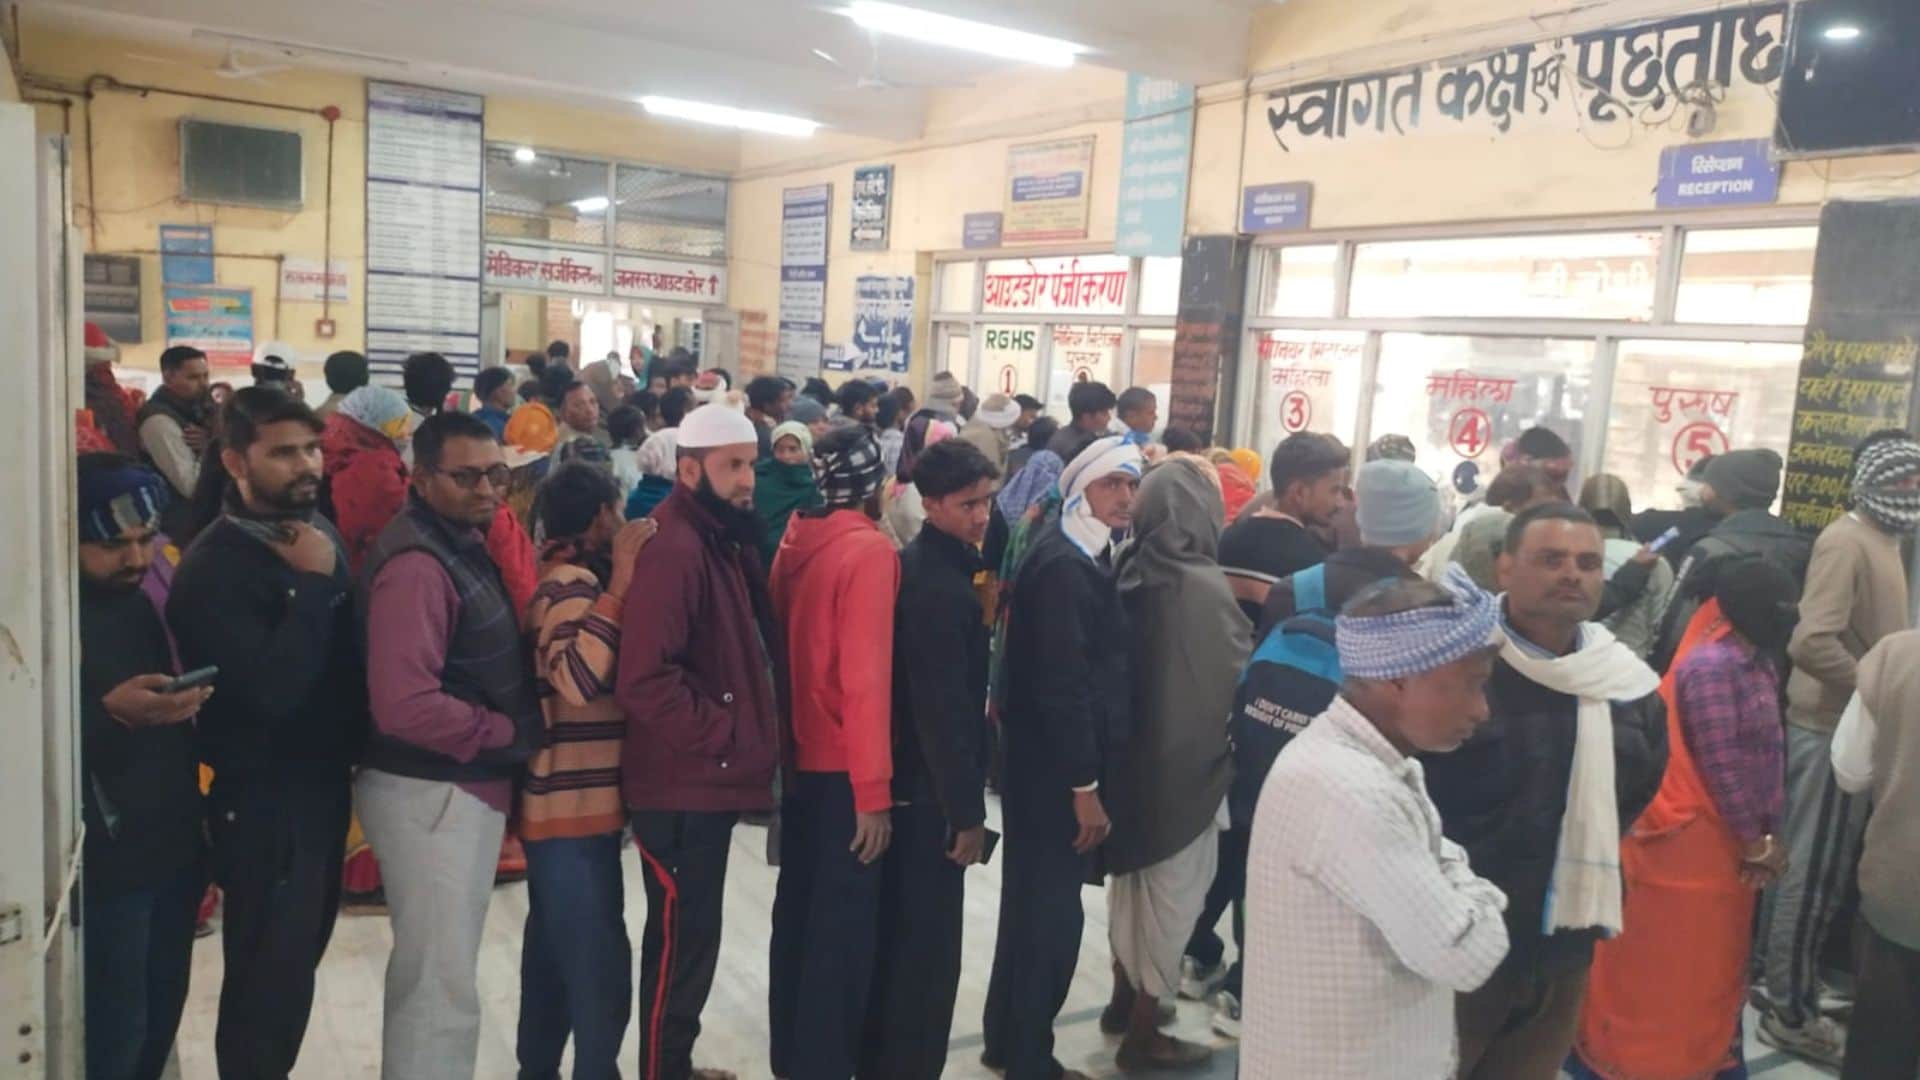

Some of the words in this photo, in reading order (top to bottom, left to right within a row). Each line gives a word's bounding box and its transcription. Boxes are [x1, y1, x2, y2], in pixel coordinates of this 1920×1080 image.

[1267, 74, 1423, 152] स्वागत
[1436, 44, 1537, 133] कक्ष
[1571, 6, 1787, 122] पूछताछ
[1677, 178, 1755, 197] RECEPTION
[985, 258, 1048, 308] आउटडोर
[1051, 256, 1128, 308] पंजीकरण
[985, 329, 1036, 351] RGHS
[1425, 368, 1518, 405] महिला
[1648, 386, 1740, 424] पुरुष
